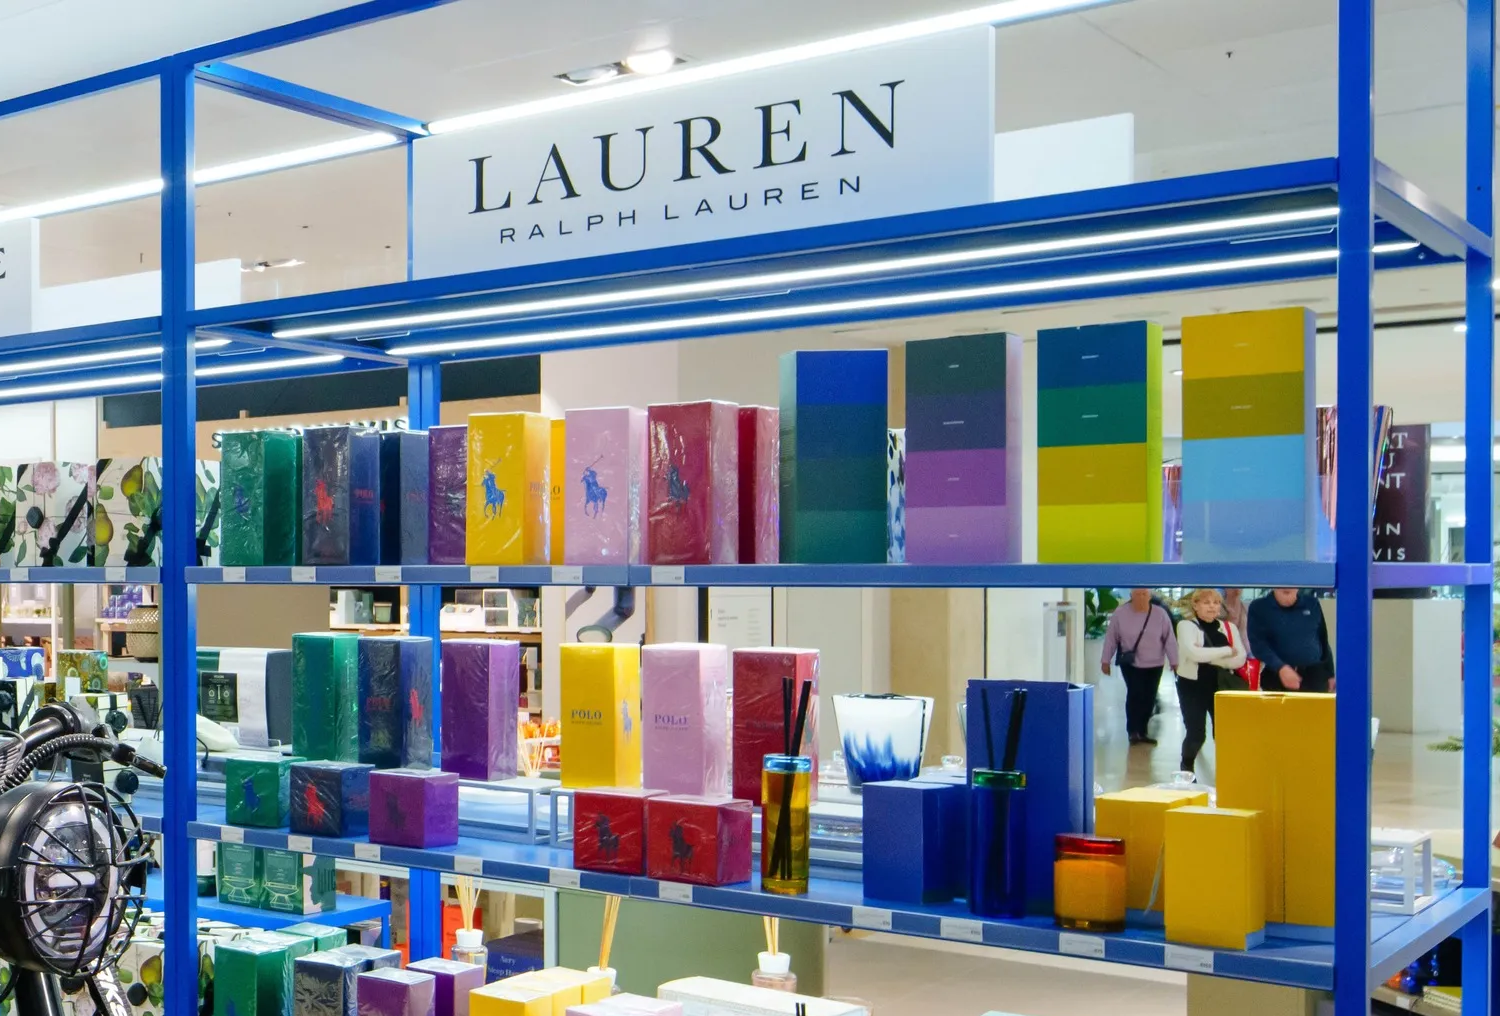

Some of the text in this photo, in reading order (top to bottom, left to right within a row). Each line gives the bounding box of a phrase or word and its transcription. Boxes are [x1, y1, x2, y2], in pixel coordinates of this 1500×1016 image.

[468, 80, 905, 214] LAUREN
[499, 175, 861, 244] RALPH LAUREN
[571, 710, 602, 720] POLO
[654, 714, 687, 725] POLO
